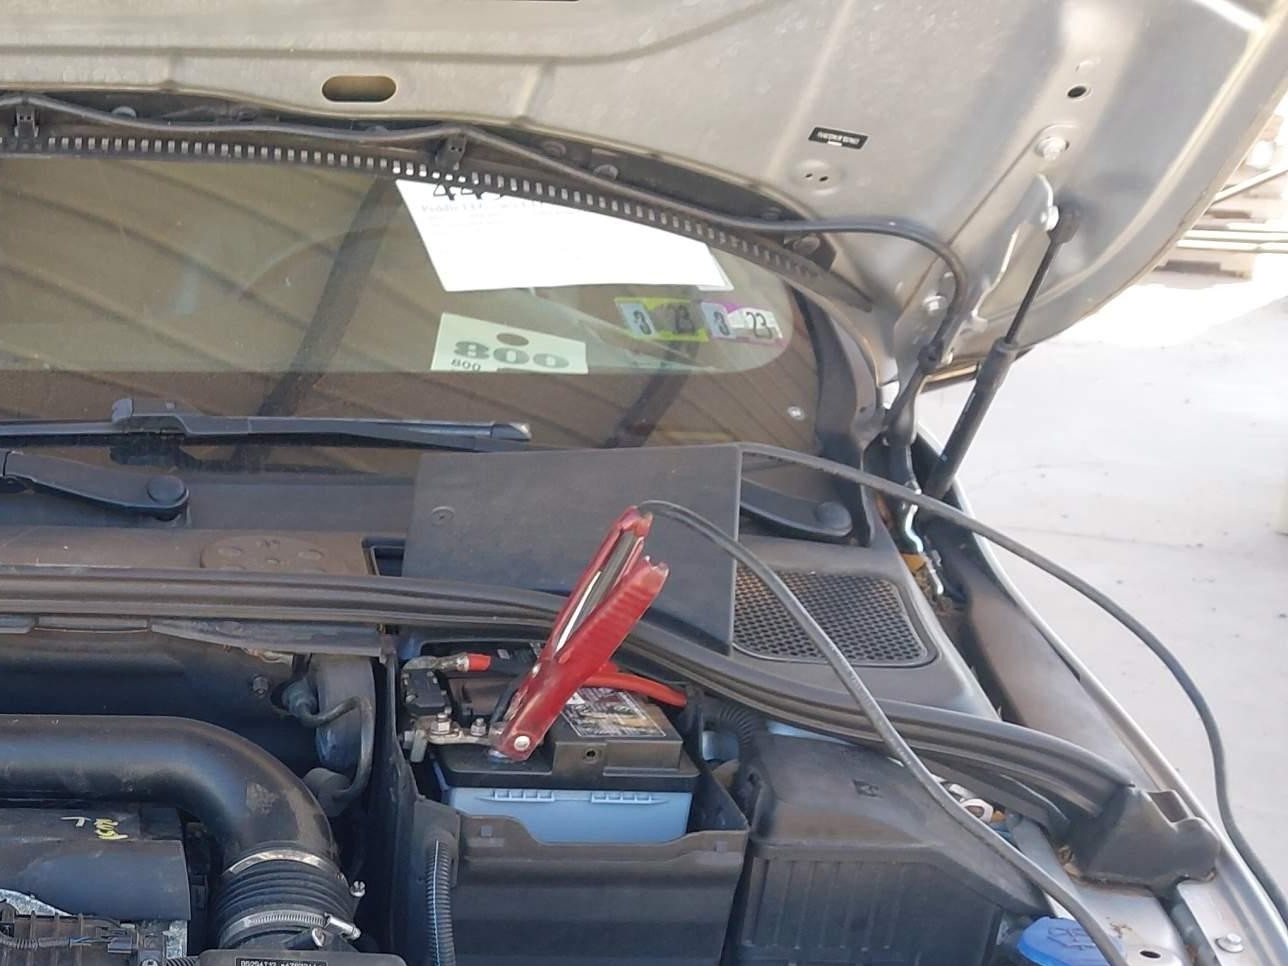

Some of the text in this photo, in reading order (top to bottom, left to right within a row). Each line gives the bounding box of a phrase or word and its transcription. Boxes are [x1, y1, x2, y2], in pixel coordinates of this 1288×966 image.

[633, 310, 652, 335] 3
[714, 311, 774, 339] 3 23
